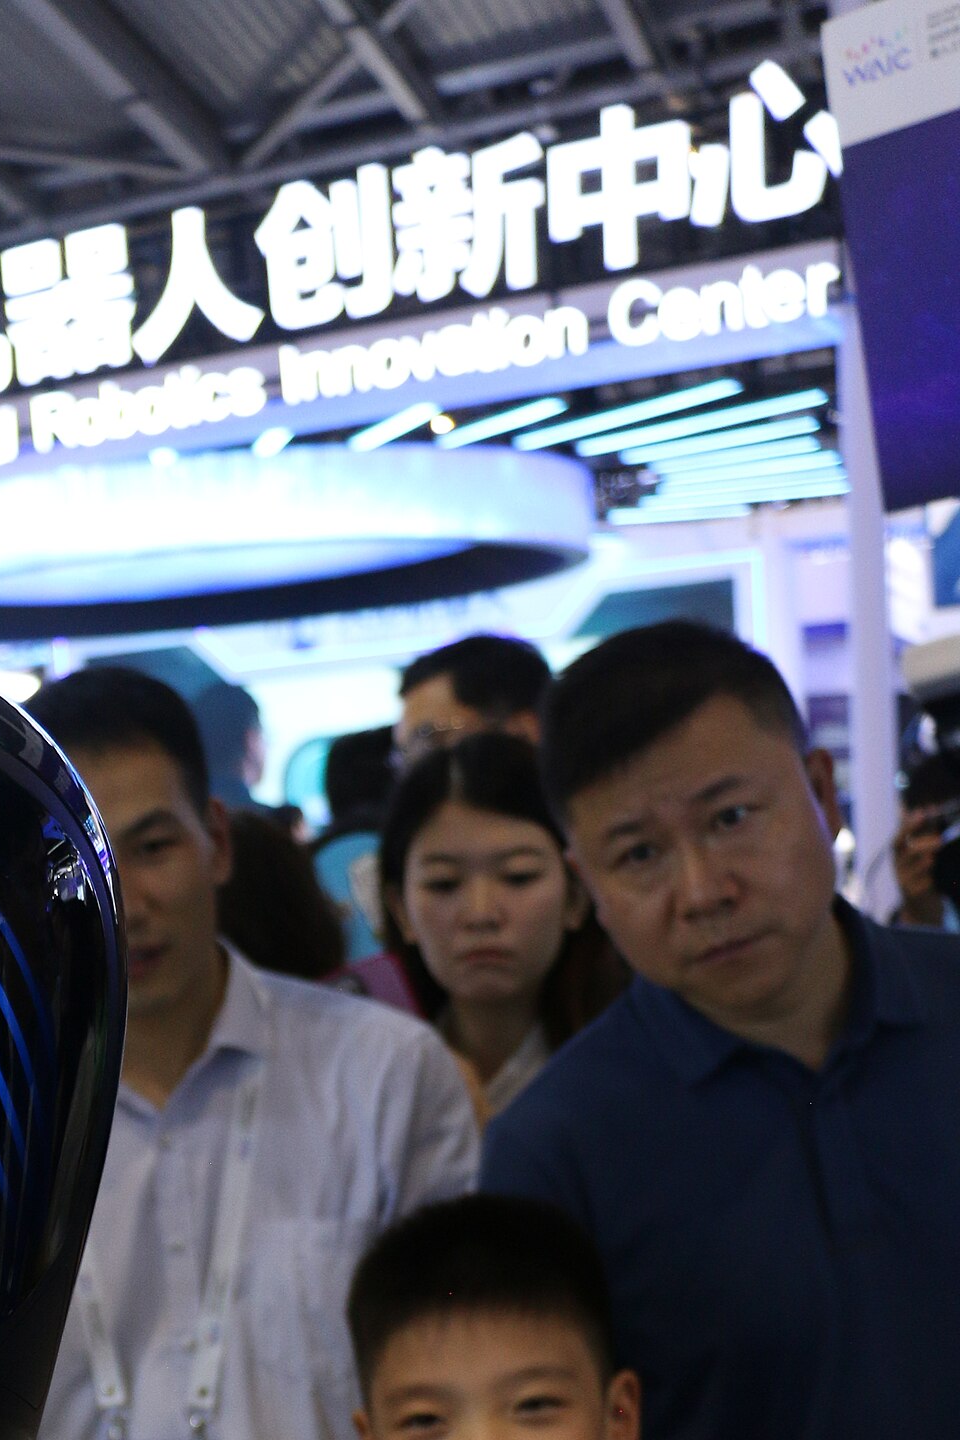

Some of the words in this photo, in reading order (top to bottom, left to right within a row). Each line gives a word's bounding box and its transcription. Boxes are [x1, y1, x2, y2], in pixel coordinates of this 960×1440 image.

[29, 364, 267, 454] Robotics
[278, 304, 589, 405] Innovation
[606, 259, 841, 346] Center
